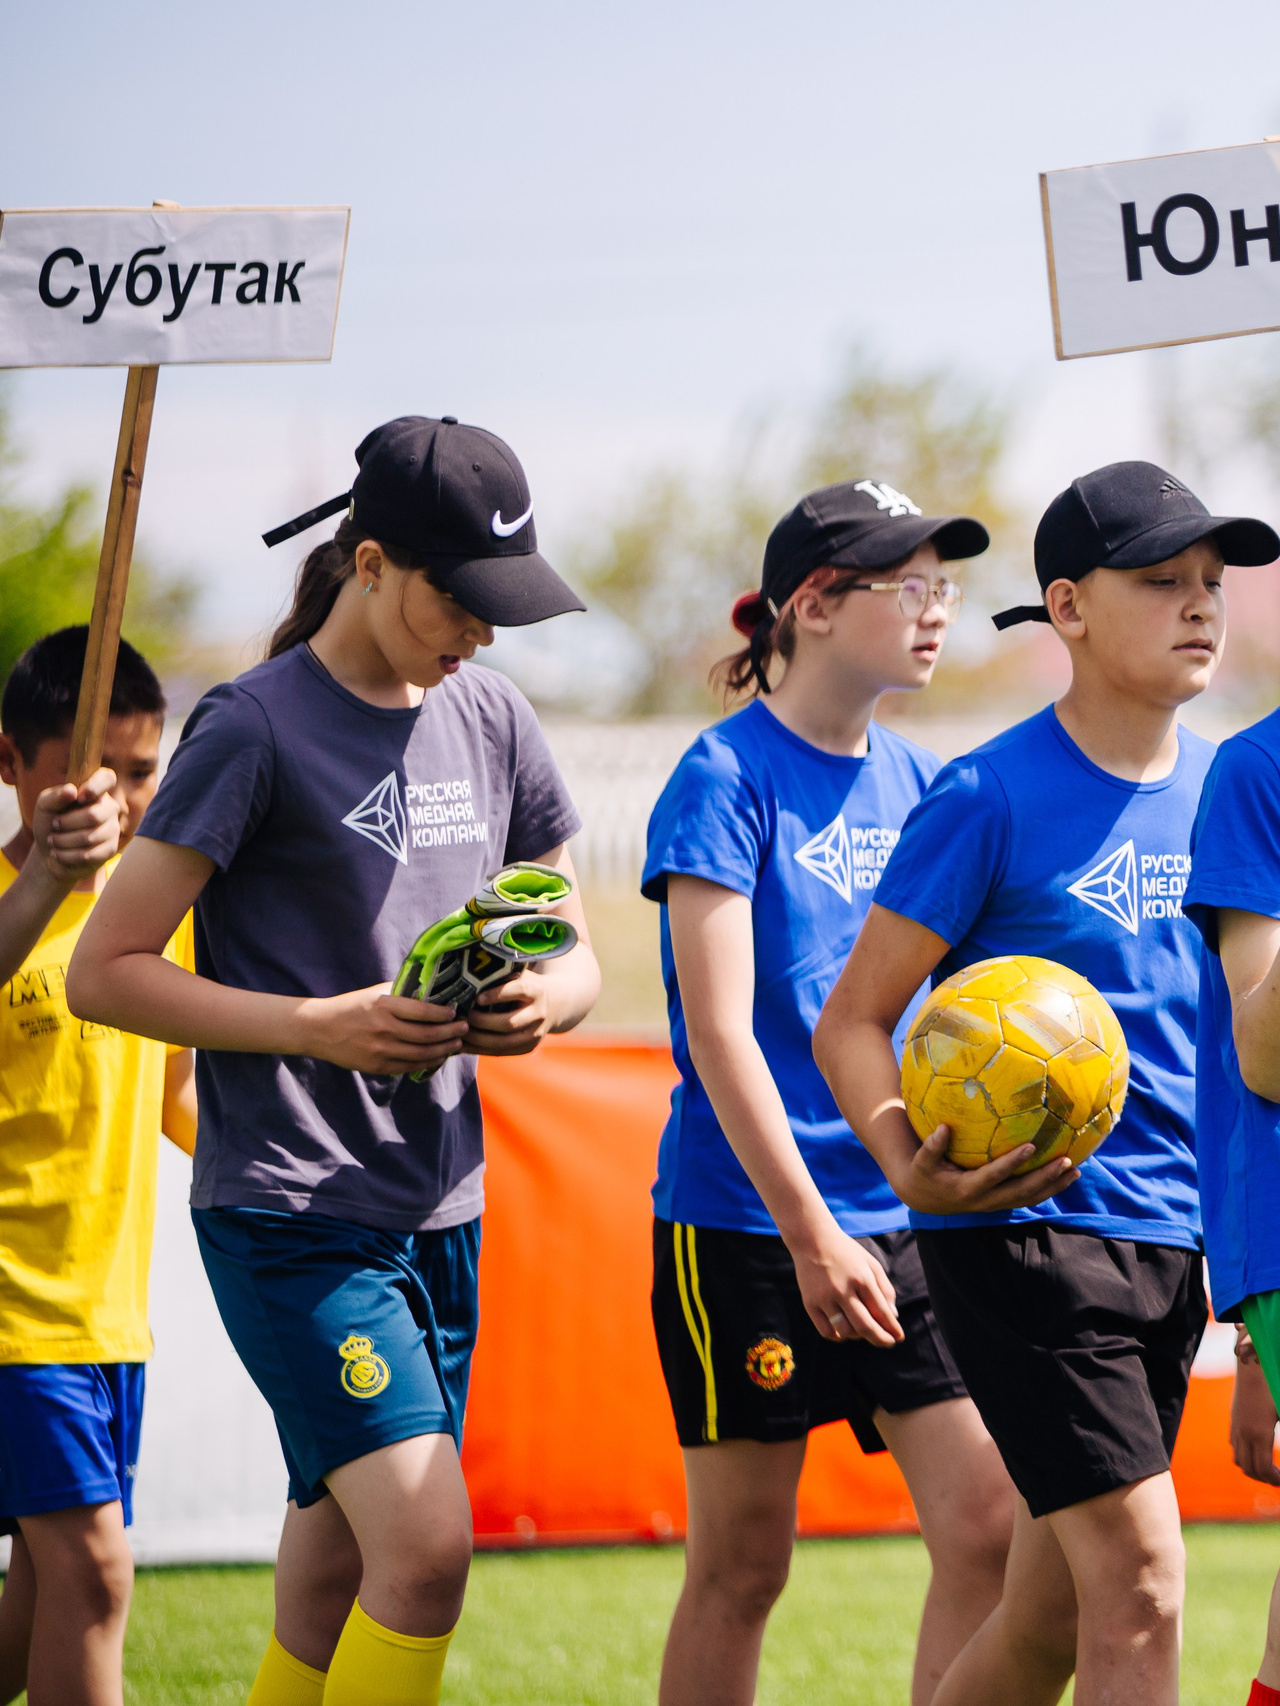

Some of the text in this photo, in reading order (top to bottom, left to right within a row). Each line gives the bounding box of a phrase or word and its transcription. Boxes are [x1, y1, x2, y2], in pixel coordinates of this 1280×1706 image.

[38, 245, 306, 324] Субутак
[404, 779, 472, 804] РУССКАЯ
[408, 802, 475, 827] МЕДНАЯ
[412, 822, 488, 848] КОМПАНИ
[850, 827, 901, 849] РУССК
[852, 847, 893, 869] МЕД
[1140, 854, 1192, 874] РУССК
[1142, 876, 1188, 897] МЕД
